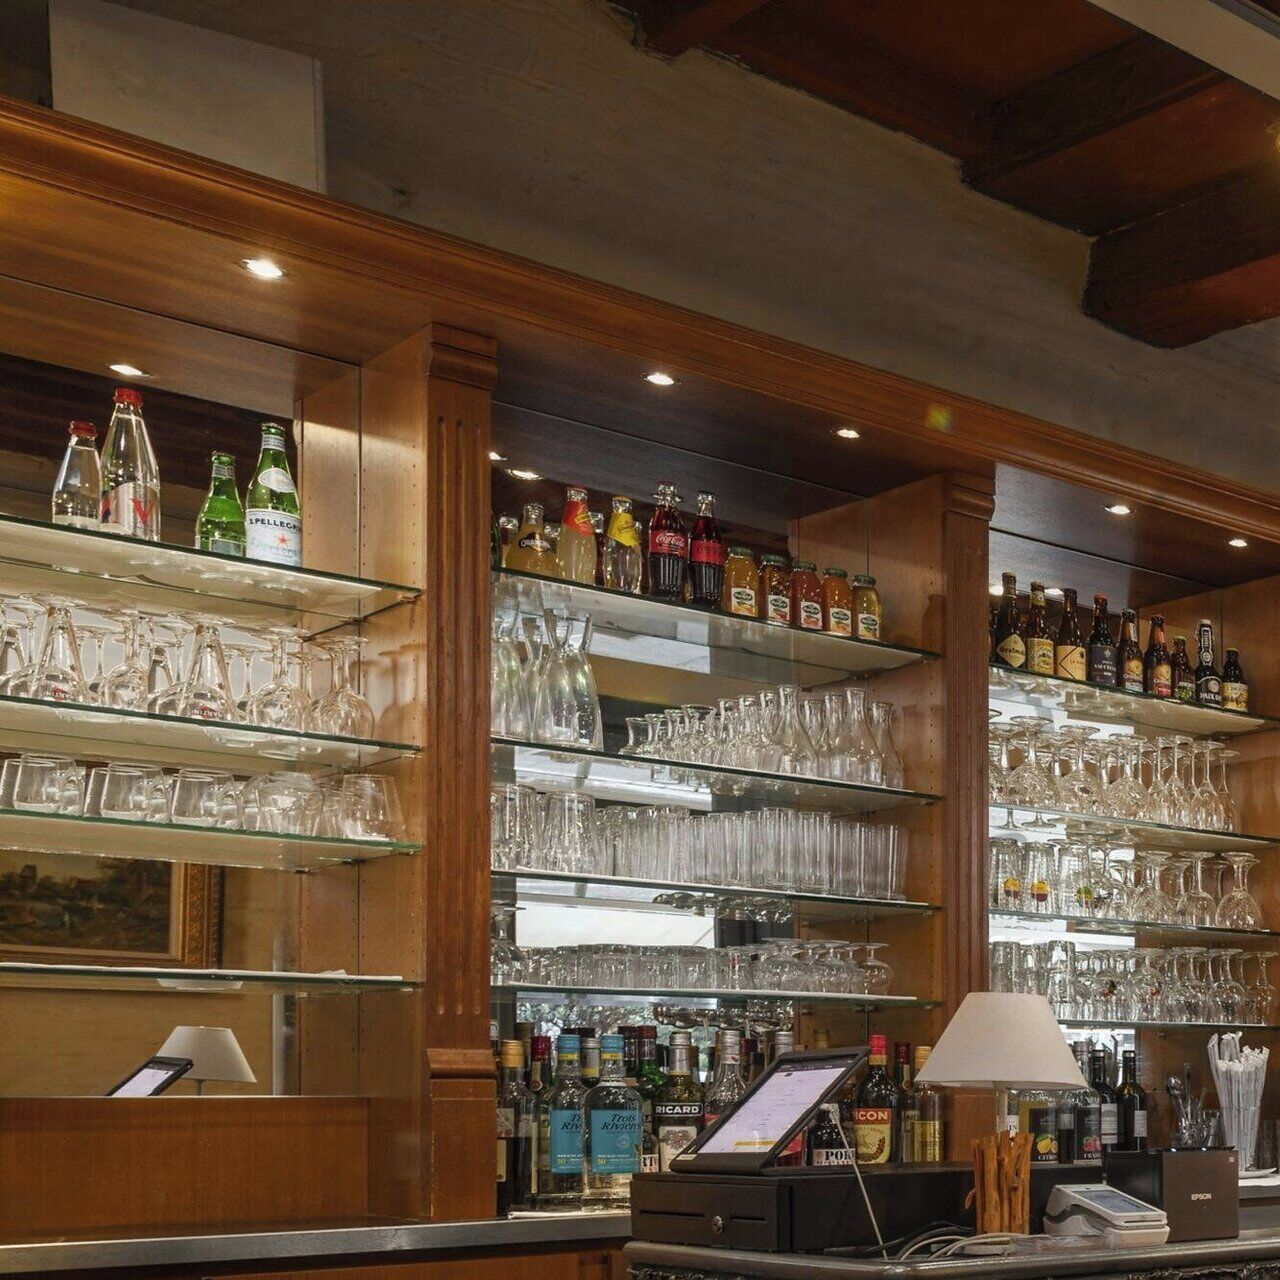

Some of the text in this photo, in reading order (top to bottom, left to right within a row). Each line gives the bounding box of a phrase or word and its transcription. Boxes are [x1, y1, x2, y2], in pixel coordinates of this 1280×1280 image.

[655, 1105, 699, 1114] RICARD
[610, 1113, 637, 1122] Trois
[853, 1110, 888, 1121] ICON
